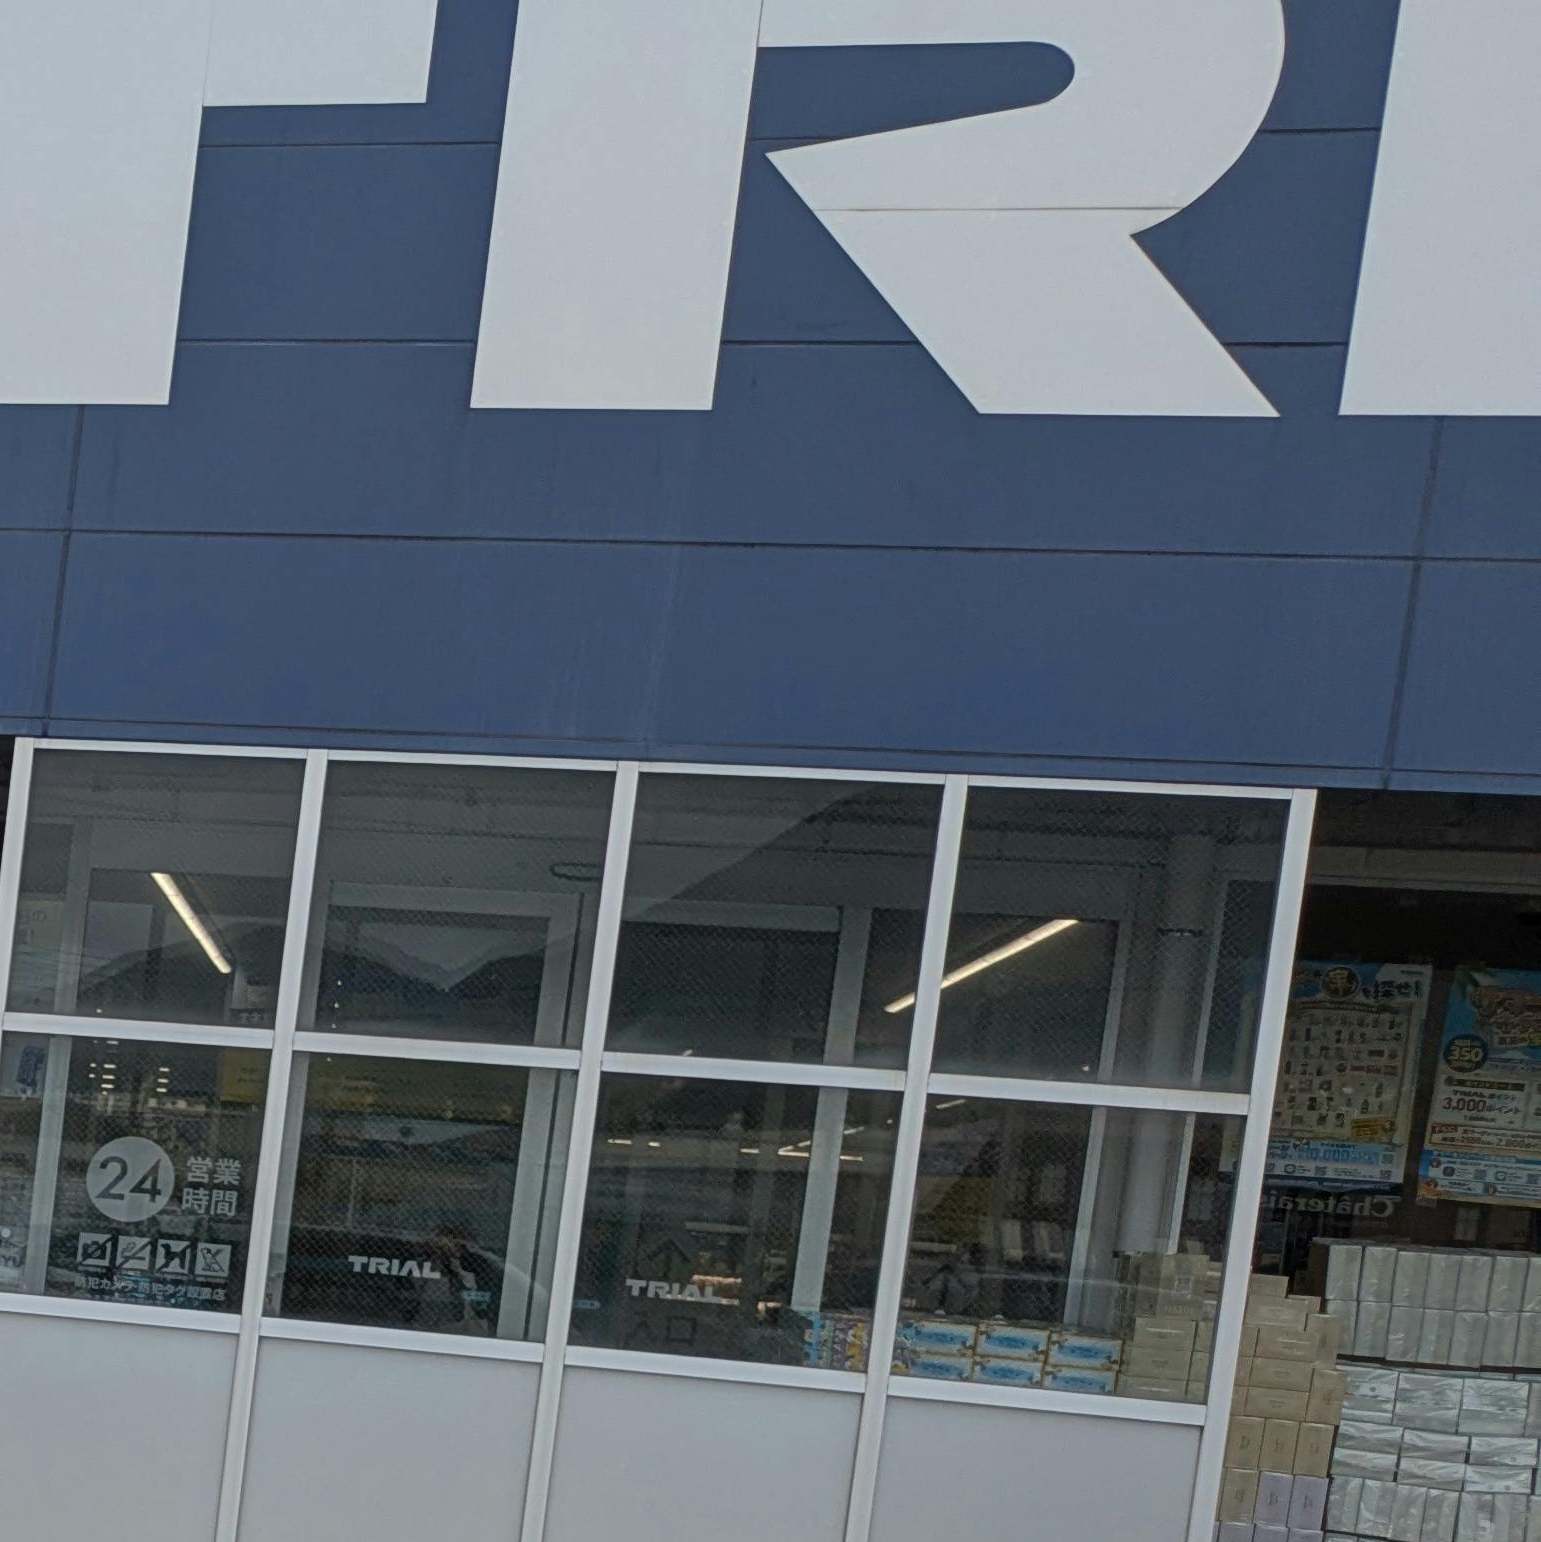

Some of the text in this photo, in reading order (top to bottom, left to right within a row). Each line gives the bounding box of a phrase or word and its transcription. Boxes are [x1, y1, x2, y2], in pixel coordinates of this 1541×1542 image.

[95, 1156, 163, 1203] 24
[186, 1156, 242, 1187] 営業
[180, 1188, 239, 1217] 時間
[347, 1255, 441, 1279] TRIAL
[625, 1278, 723, 1305] TRIAL
